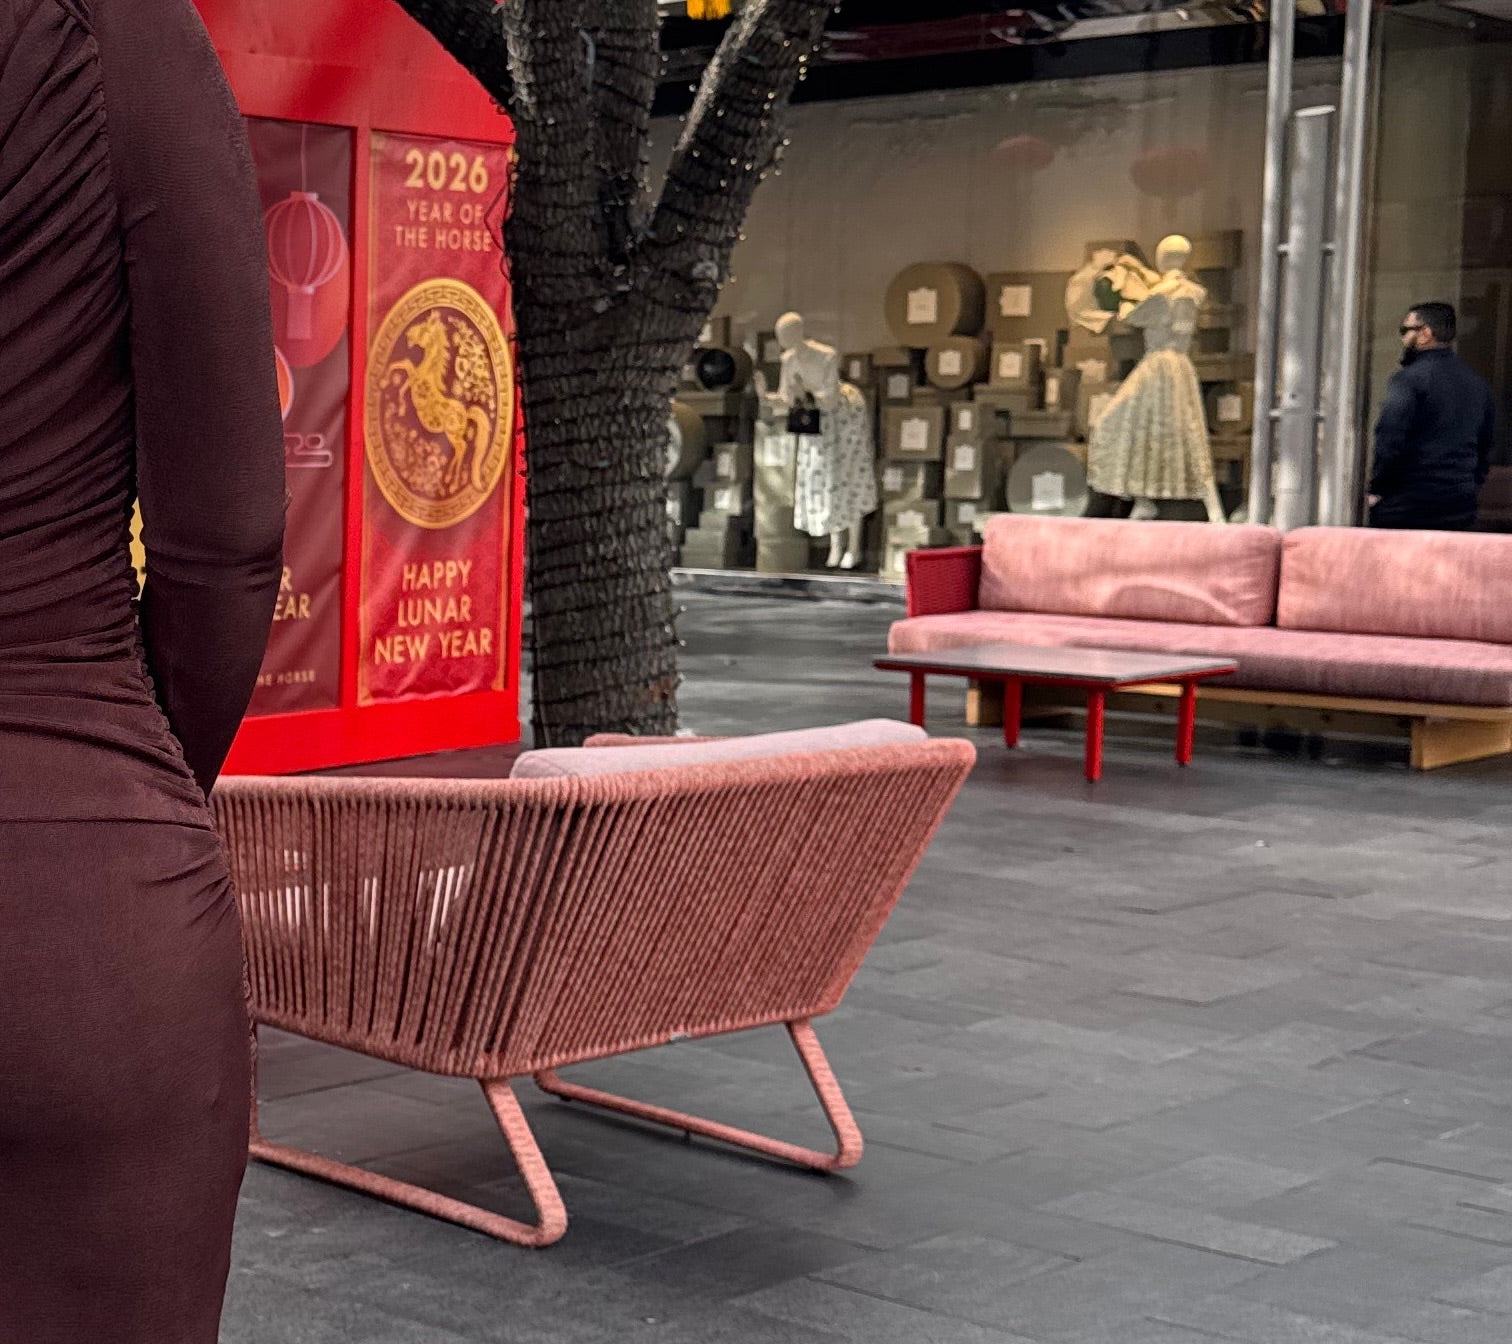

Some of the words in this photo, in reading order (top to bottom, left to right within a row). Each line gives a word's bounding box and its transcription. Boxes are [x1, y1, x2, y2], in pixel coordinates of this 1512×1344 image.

[405, 148, 489, 194] 2026
[407, 199, 453, 223] YEAR
[459, 203, 484, 225] OF
[395, 223, 428, 248] THE
[435, 227, 493, 252] HORSE
[402, 559, 473, 591] HAPPY
[273, 592, 311, 621] EAR
[397, 594, 472, 627] LUNAR
[374, 632, 430, 665] NEW
[438, 627, 492, 659] YEAR
